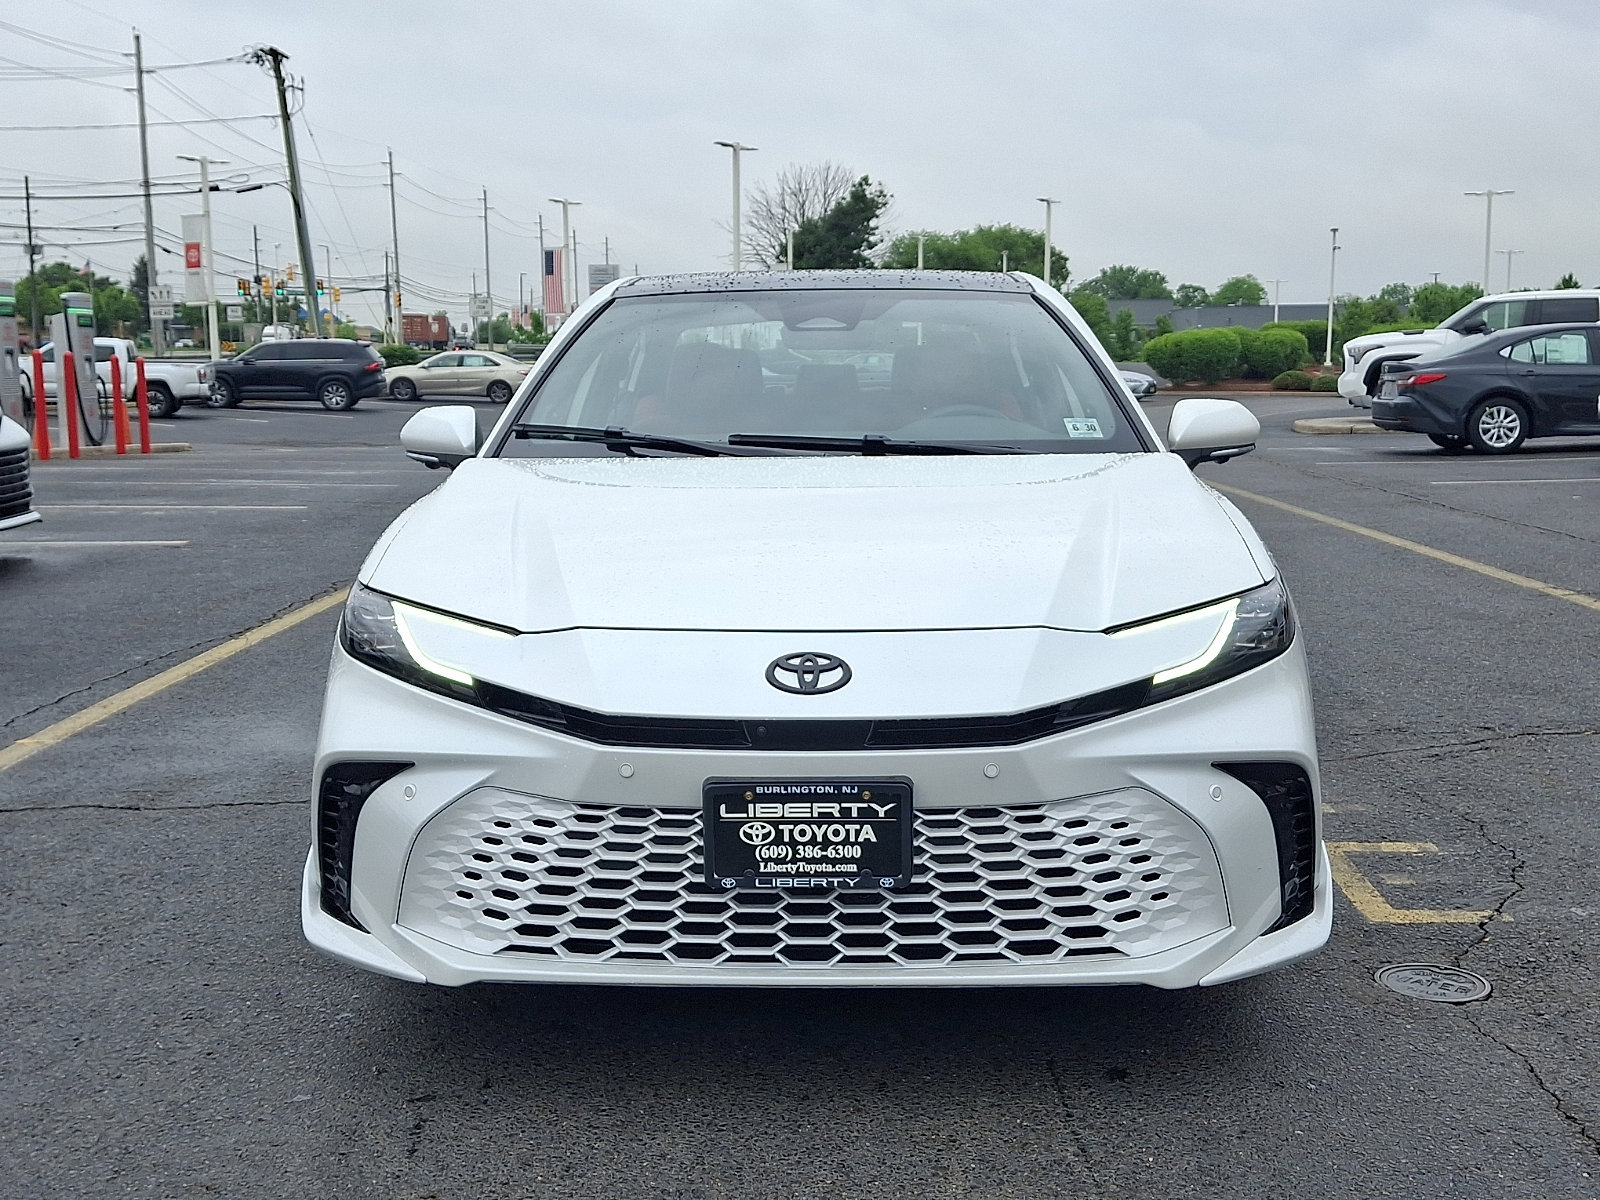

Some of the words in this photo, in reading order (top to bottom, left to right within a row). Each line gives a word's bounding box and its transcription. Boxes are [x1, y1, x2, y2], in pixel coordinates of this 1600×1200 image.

[1072, 423, 1080, 431] 6
[1085, 423, 1097, 431] 30
[756, 786, 838, 794] BURLINGTON,
[842, 786, 858, 794] NJ
[719, 803, 897, 818] LIBERTY
[778, 824, 878, 843] TOYOTA
[755, 845, 792, 860] (609)
[795, 845, 862, 859] 386-6300
[759, 862, 858, 874] LibertyToyota.com
[755, 878, 861, 888] LIBERTY
